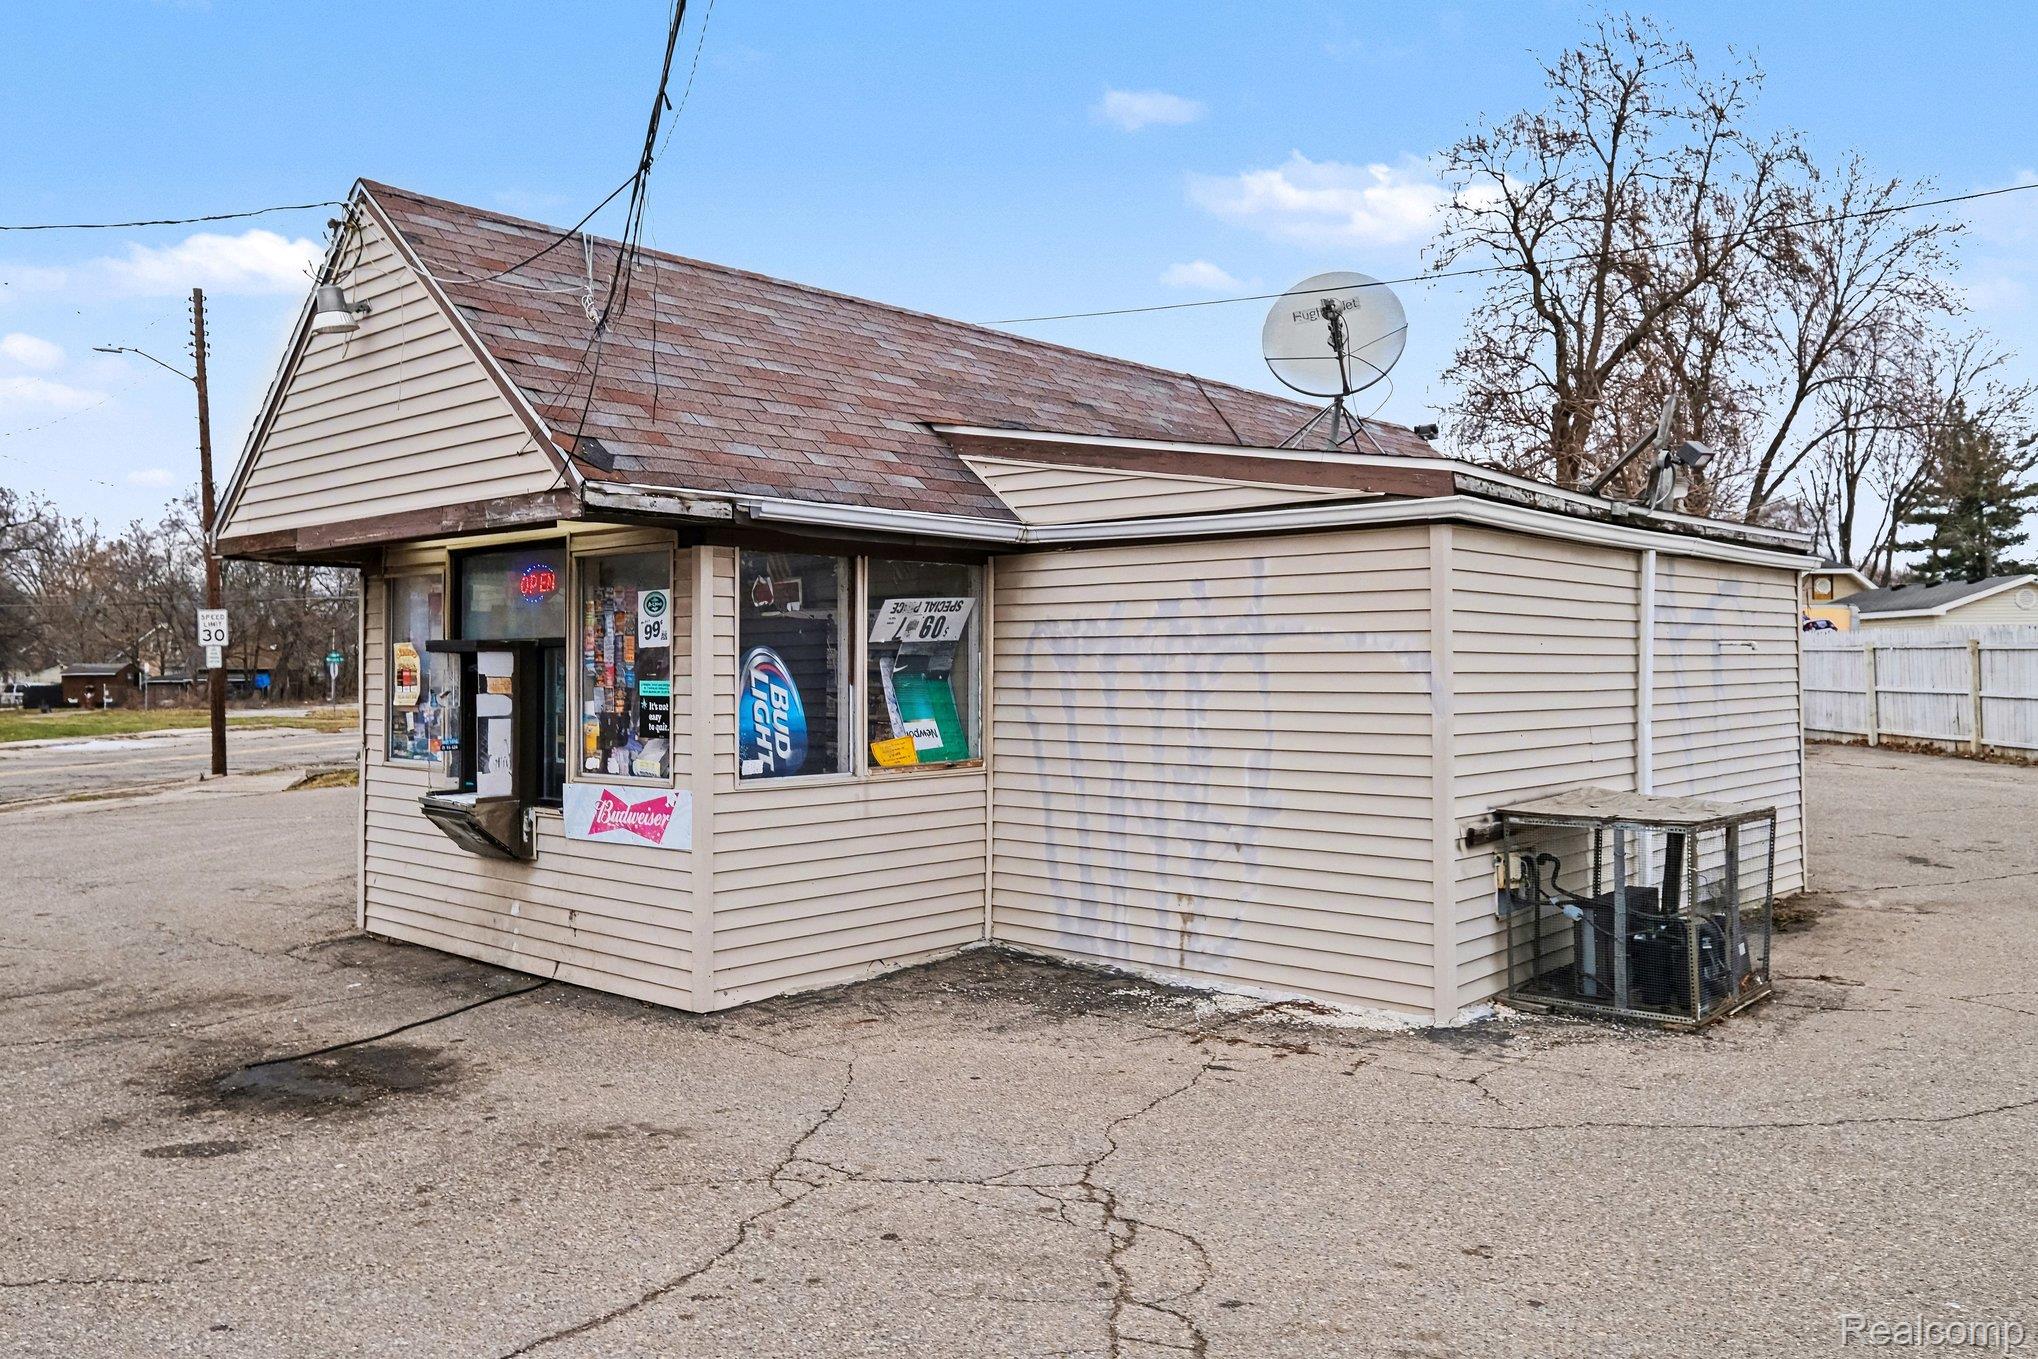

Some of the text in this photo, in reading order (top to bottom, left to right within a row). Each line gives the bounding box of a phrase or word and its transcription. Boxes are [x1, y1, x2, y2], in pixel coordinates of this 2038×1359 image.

[1292, 298, 1358, 322] Huget
[520, 572, 555, 594] OPEN
[890, 600, 964, 614] SPECIAL PCE
[202, 629, 225, 642] 30
[750, 669, 775, 772] LIGHT
[770, 683, 792, 760] BUD
[906, 728, 938, 738] Newpo
[595, 800, 671, 826] Budweiser
